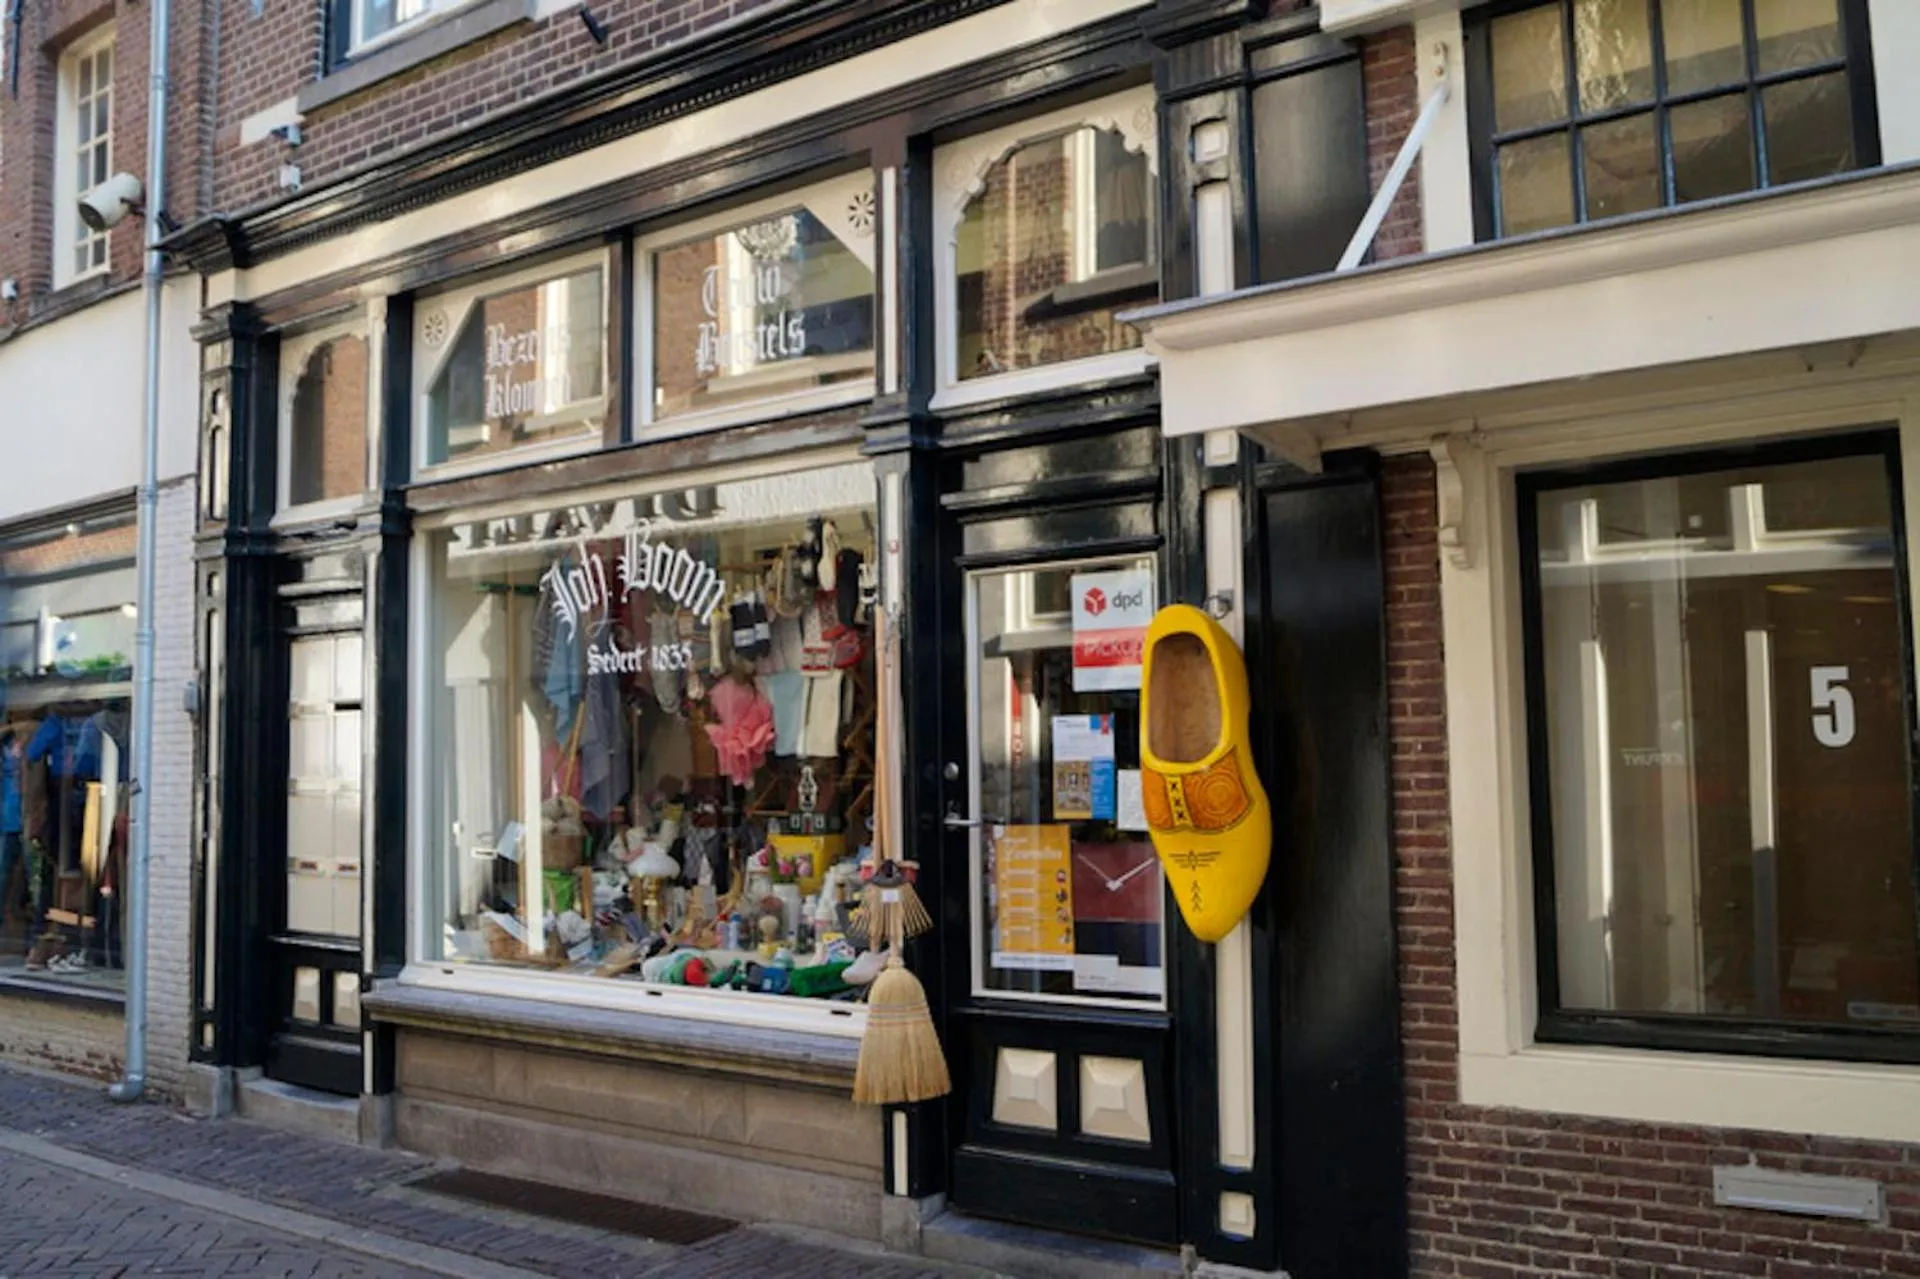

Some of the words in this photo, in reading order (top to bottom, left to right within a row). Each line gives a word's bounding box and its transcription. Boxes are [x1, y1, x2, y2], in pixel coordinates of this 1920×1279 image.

[696, 309, 806, 373] Bstels
[616, 518, 726, 625] Boom
[1112, 590, 1143, 612] dpd
[1809, 665, 1856, 748] 5
